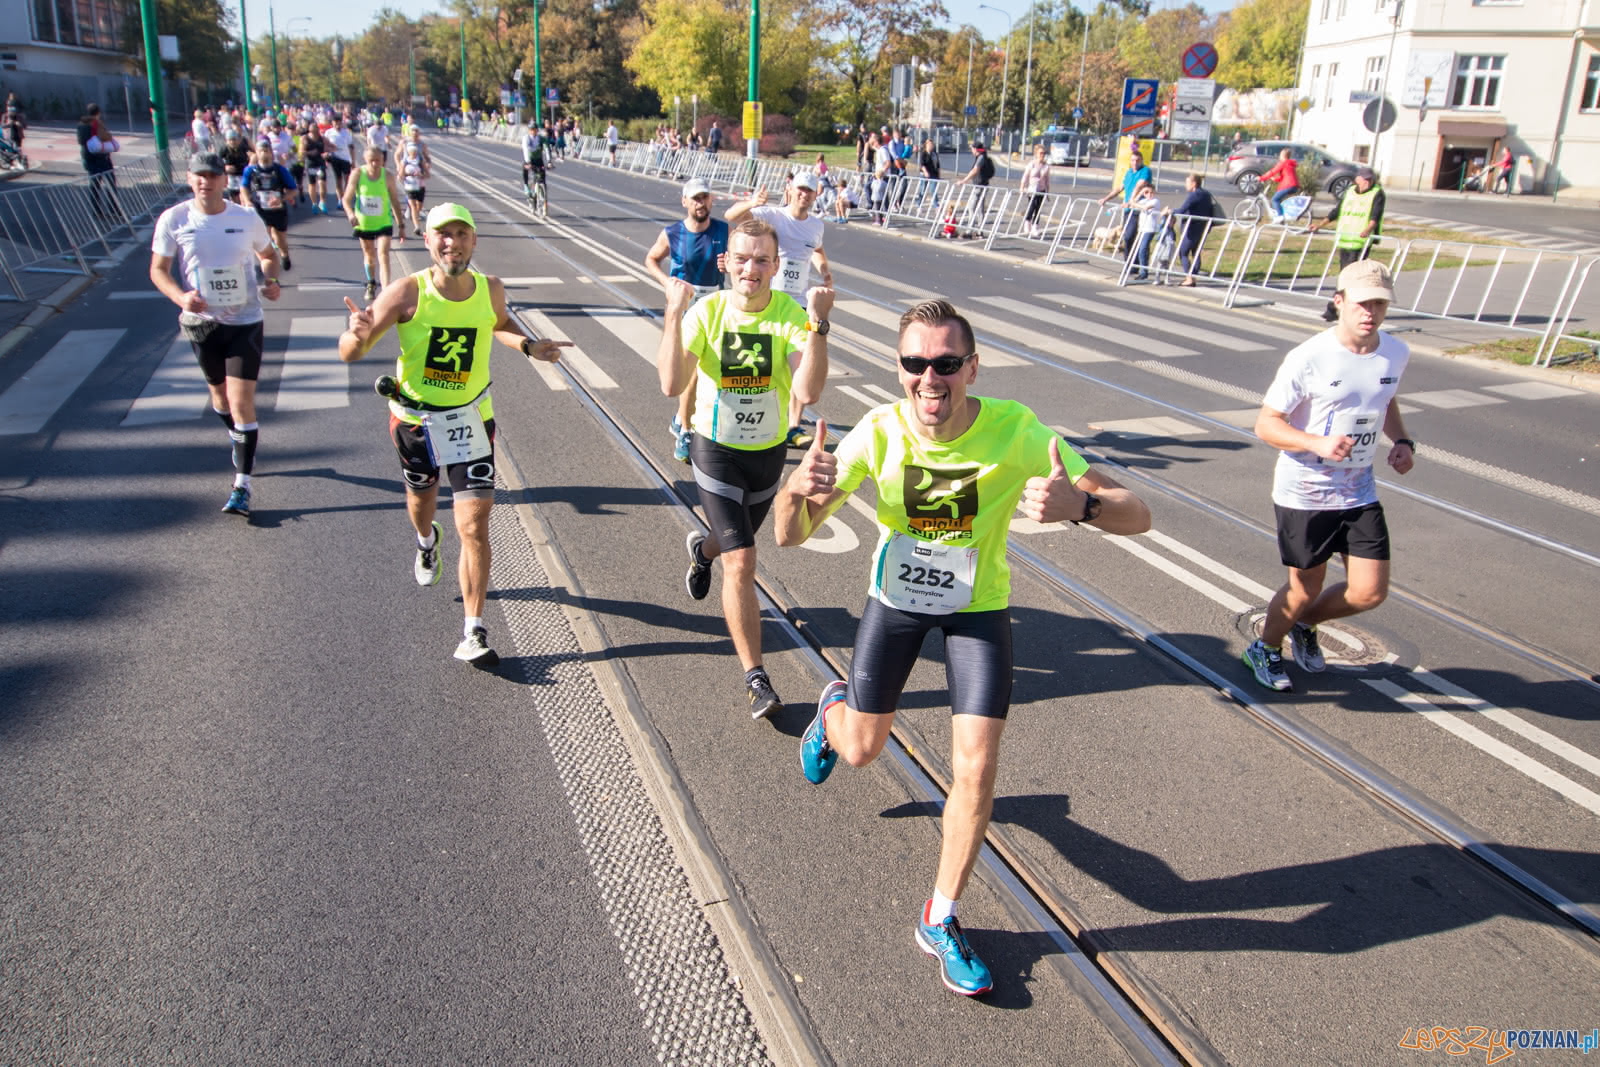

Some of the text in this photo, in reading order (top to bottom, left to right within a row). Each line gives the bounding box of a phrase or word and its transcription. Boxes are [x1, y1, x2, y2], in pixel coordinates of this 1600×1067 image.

[783, 269, 800, 280] 903
[209, 279, 238, 291] 1832
[422, 377, 466, 390] runners
[731, 375, 763, 387] night
[735, 412, 765, 425] 947
[447, 425, 474, 442] 272
[1345, 431, 1377, 447] 701
[898, 563, 955, 590] 2252
